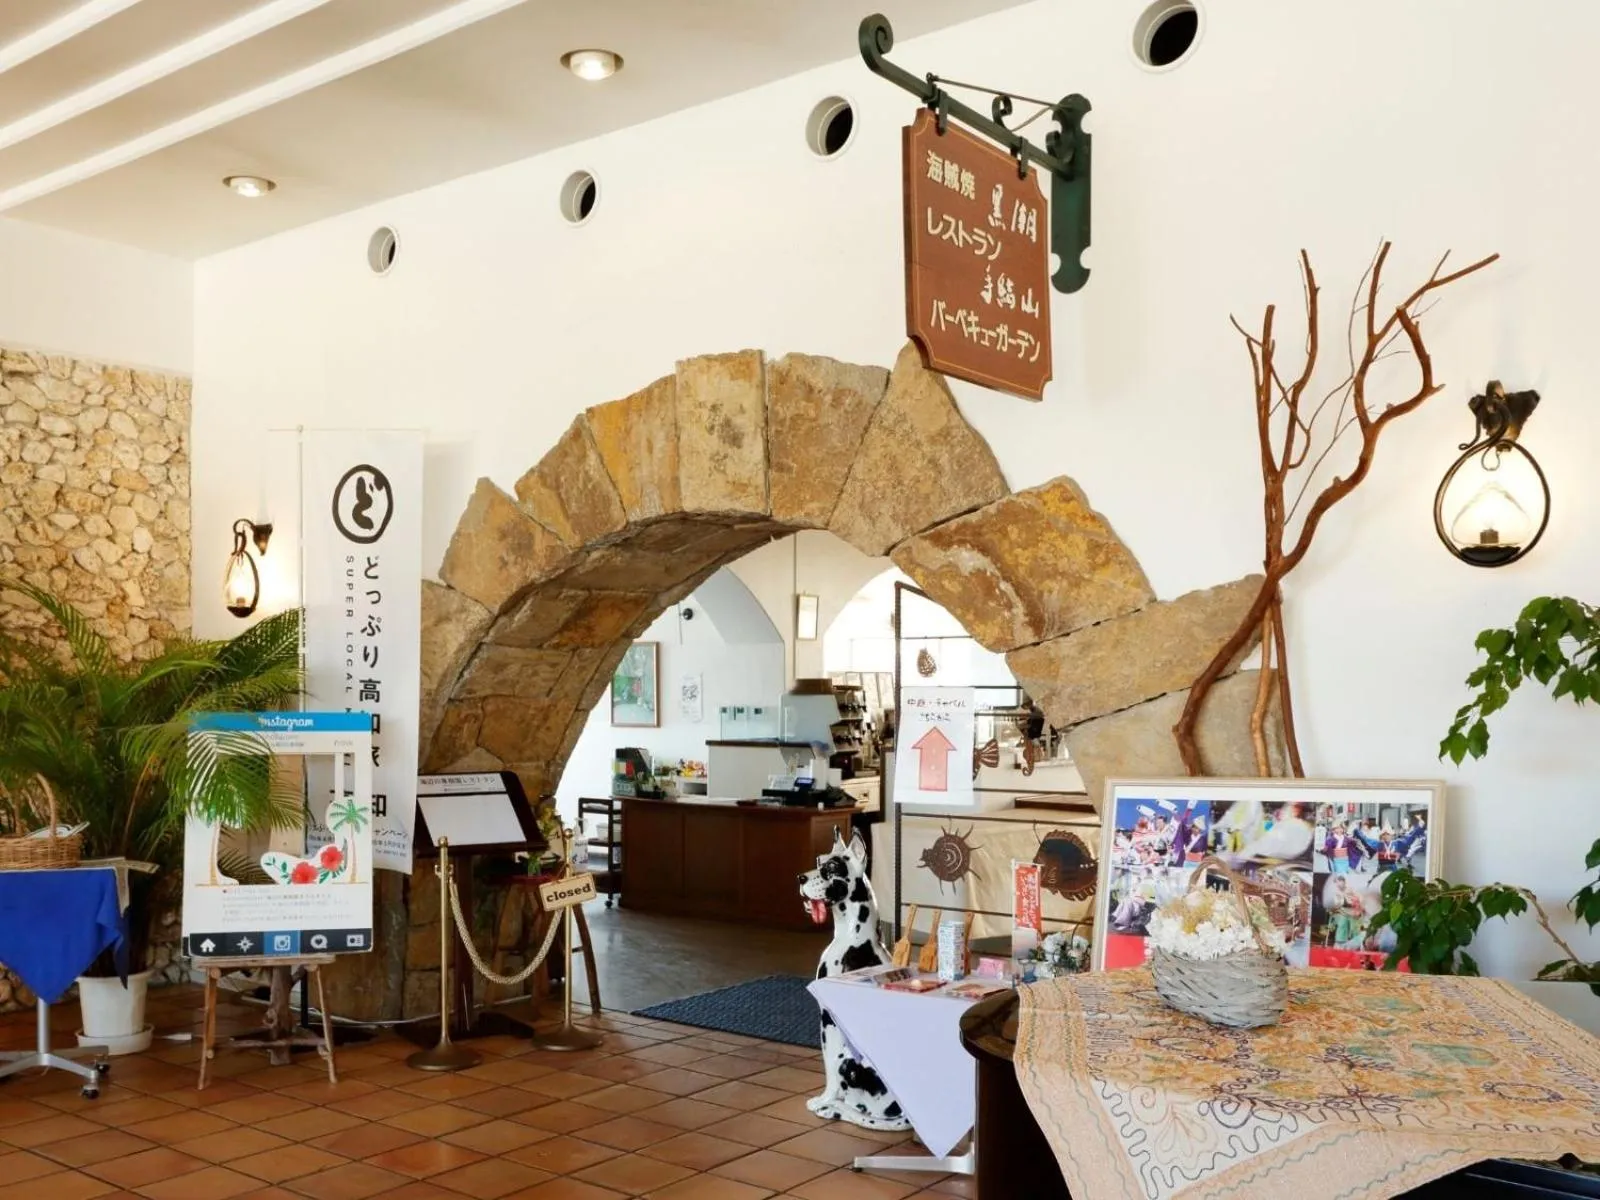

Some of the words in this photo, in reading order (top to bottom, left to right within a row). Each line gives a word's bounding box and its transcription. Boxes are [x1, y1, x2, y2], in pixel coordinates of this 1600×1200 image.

[926, 206, 1002, 261] レストラン
[930, 299, 1041, 363] バーベキューガーデン
[345, 555, 355, 618] SUPER
[345, 631, 354, 693] LOCAL
[545, 883, 592, 903] closed
